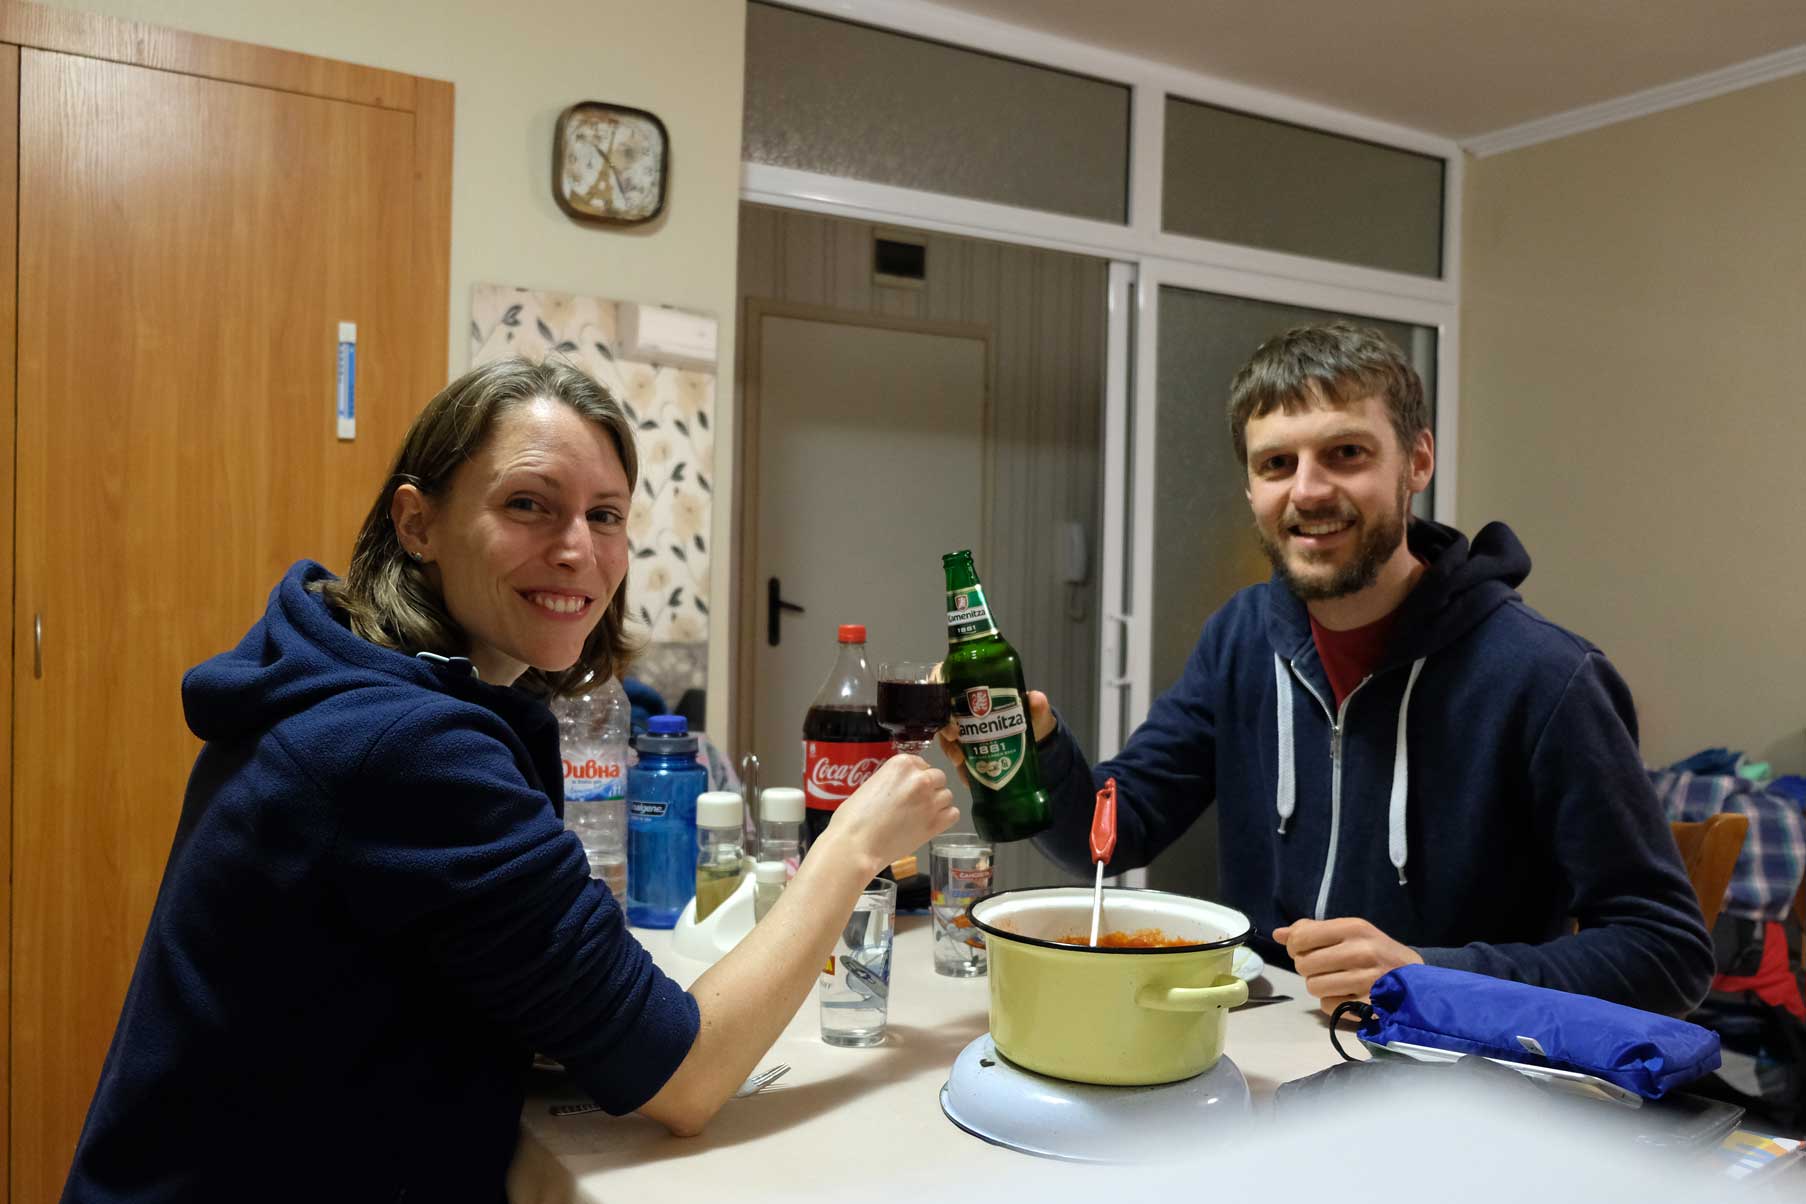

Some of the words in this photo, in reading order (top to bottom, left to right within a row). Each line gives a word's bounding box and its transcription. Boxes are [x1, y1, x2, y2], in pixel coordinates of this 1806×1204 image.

[956, 712, 1024, 738] amenitza
[973, 742, 1006, 755] 1881
[812, 757, 886, 787] Coca-Co
